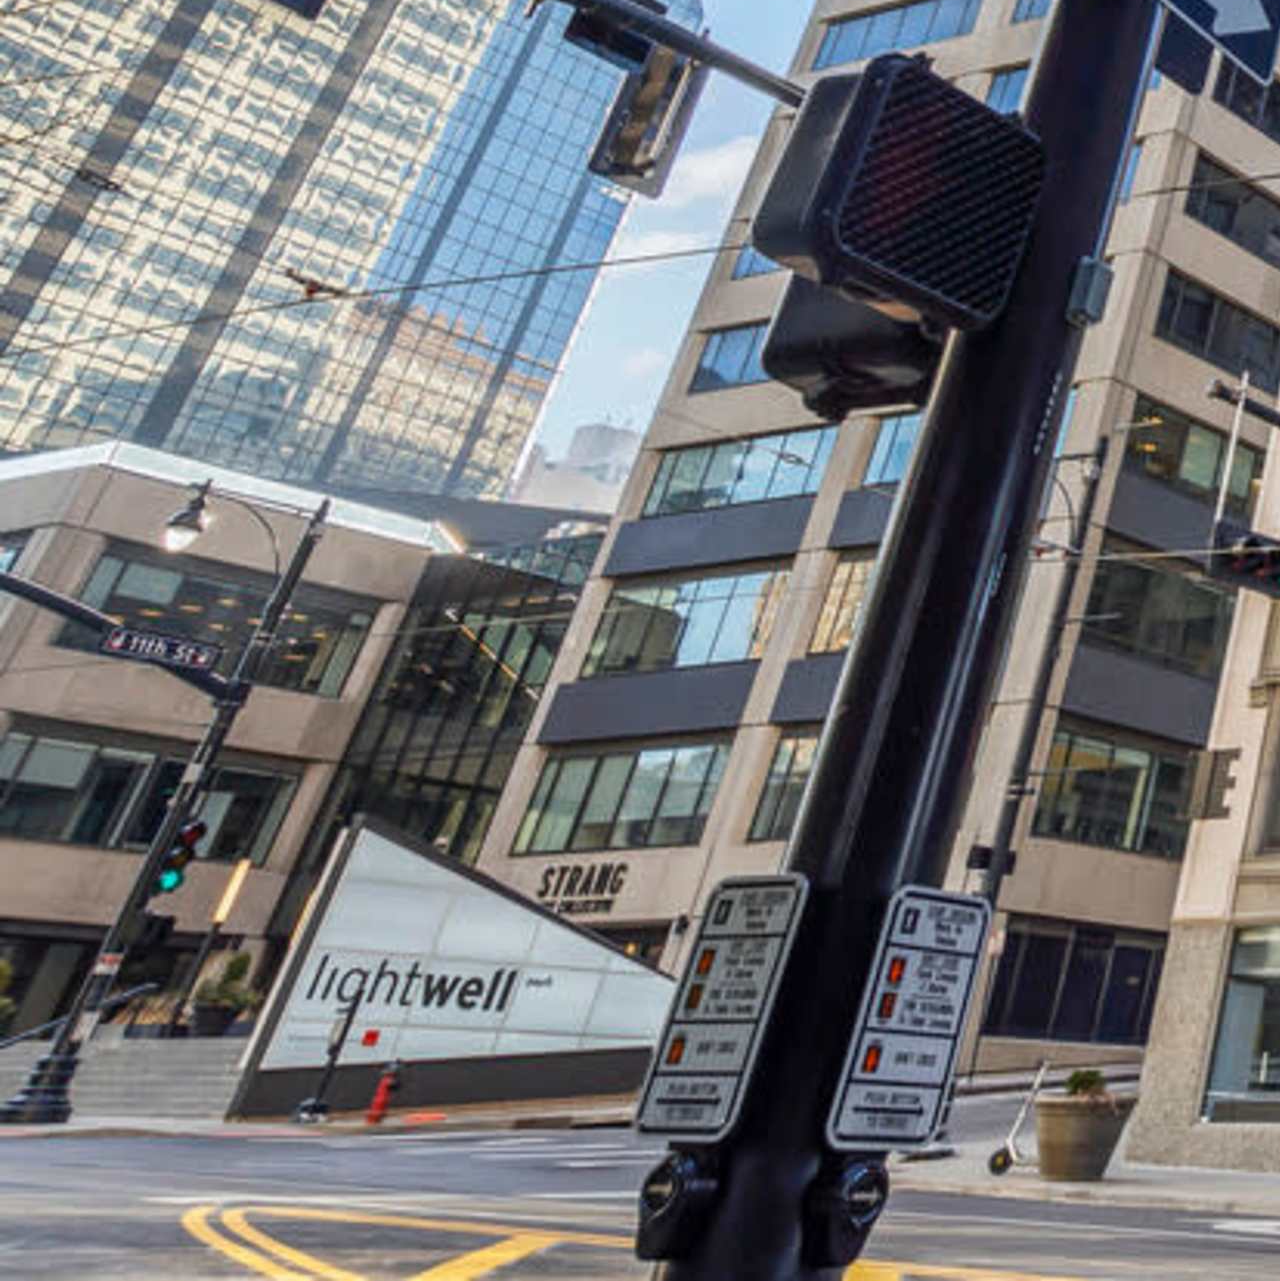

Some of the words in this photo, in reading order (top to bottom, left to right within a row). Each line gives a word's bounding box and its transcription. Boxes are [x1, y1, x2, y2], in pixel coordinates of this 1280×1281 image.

[129, 635, 165, 654] 11th
[172, 645, 195, 663] St
[537, 862, 628, 898] STRANG
[306, 954, 518, 1014] lightwell
